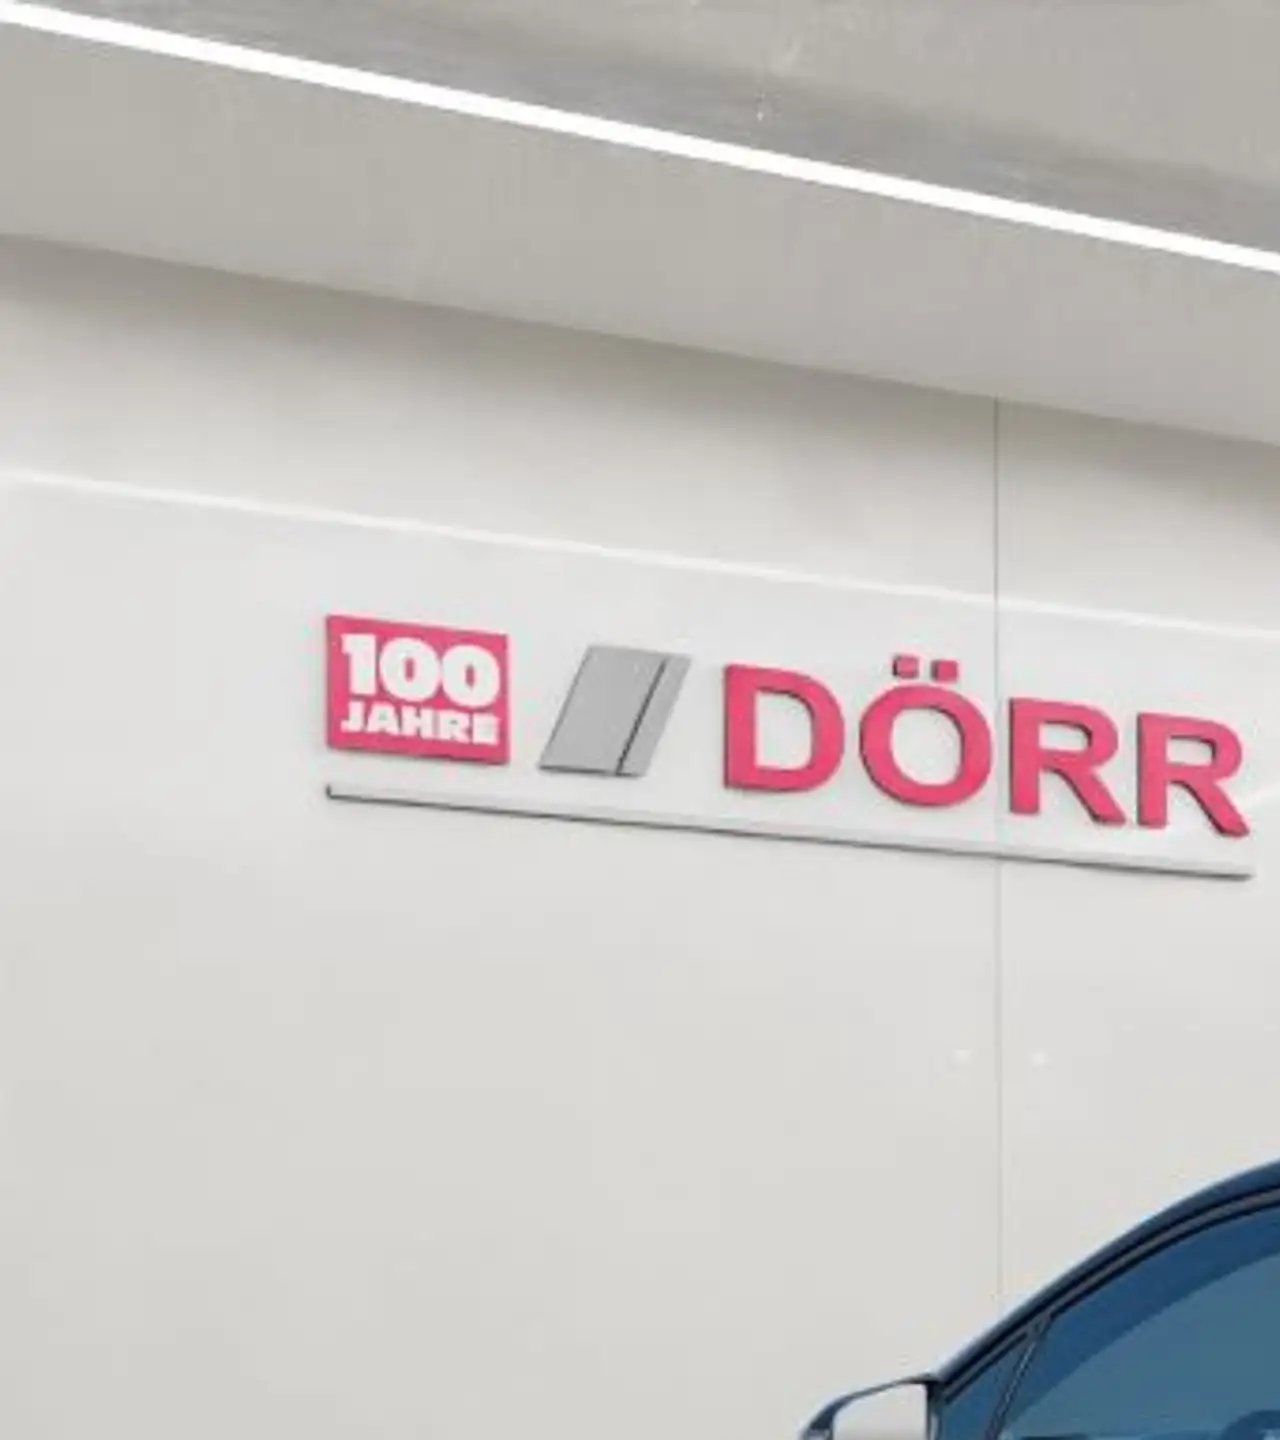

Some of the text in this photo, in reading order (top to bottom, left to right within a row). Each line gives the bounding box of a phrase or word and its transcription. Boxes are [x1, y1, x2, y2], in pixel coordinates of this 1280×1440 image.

[342, 633, 501, 707] 100
[341, 701, 501, 745] JAHRE
[723, 654, 1249, 838] DÖRR
